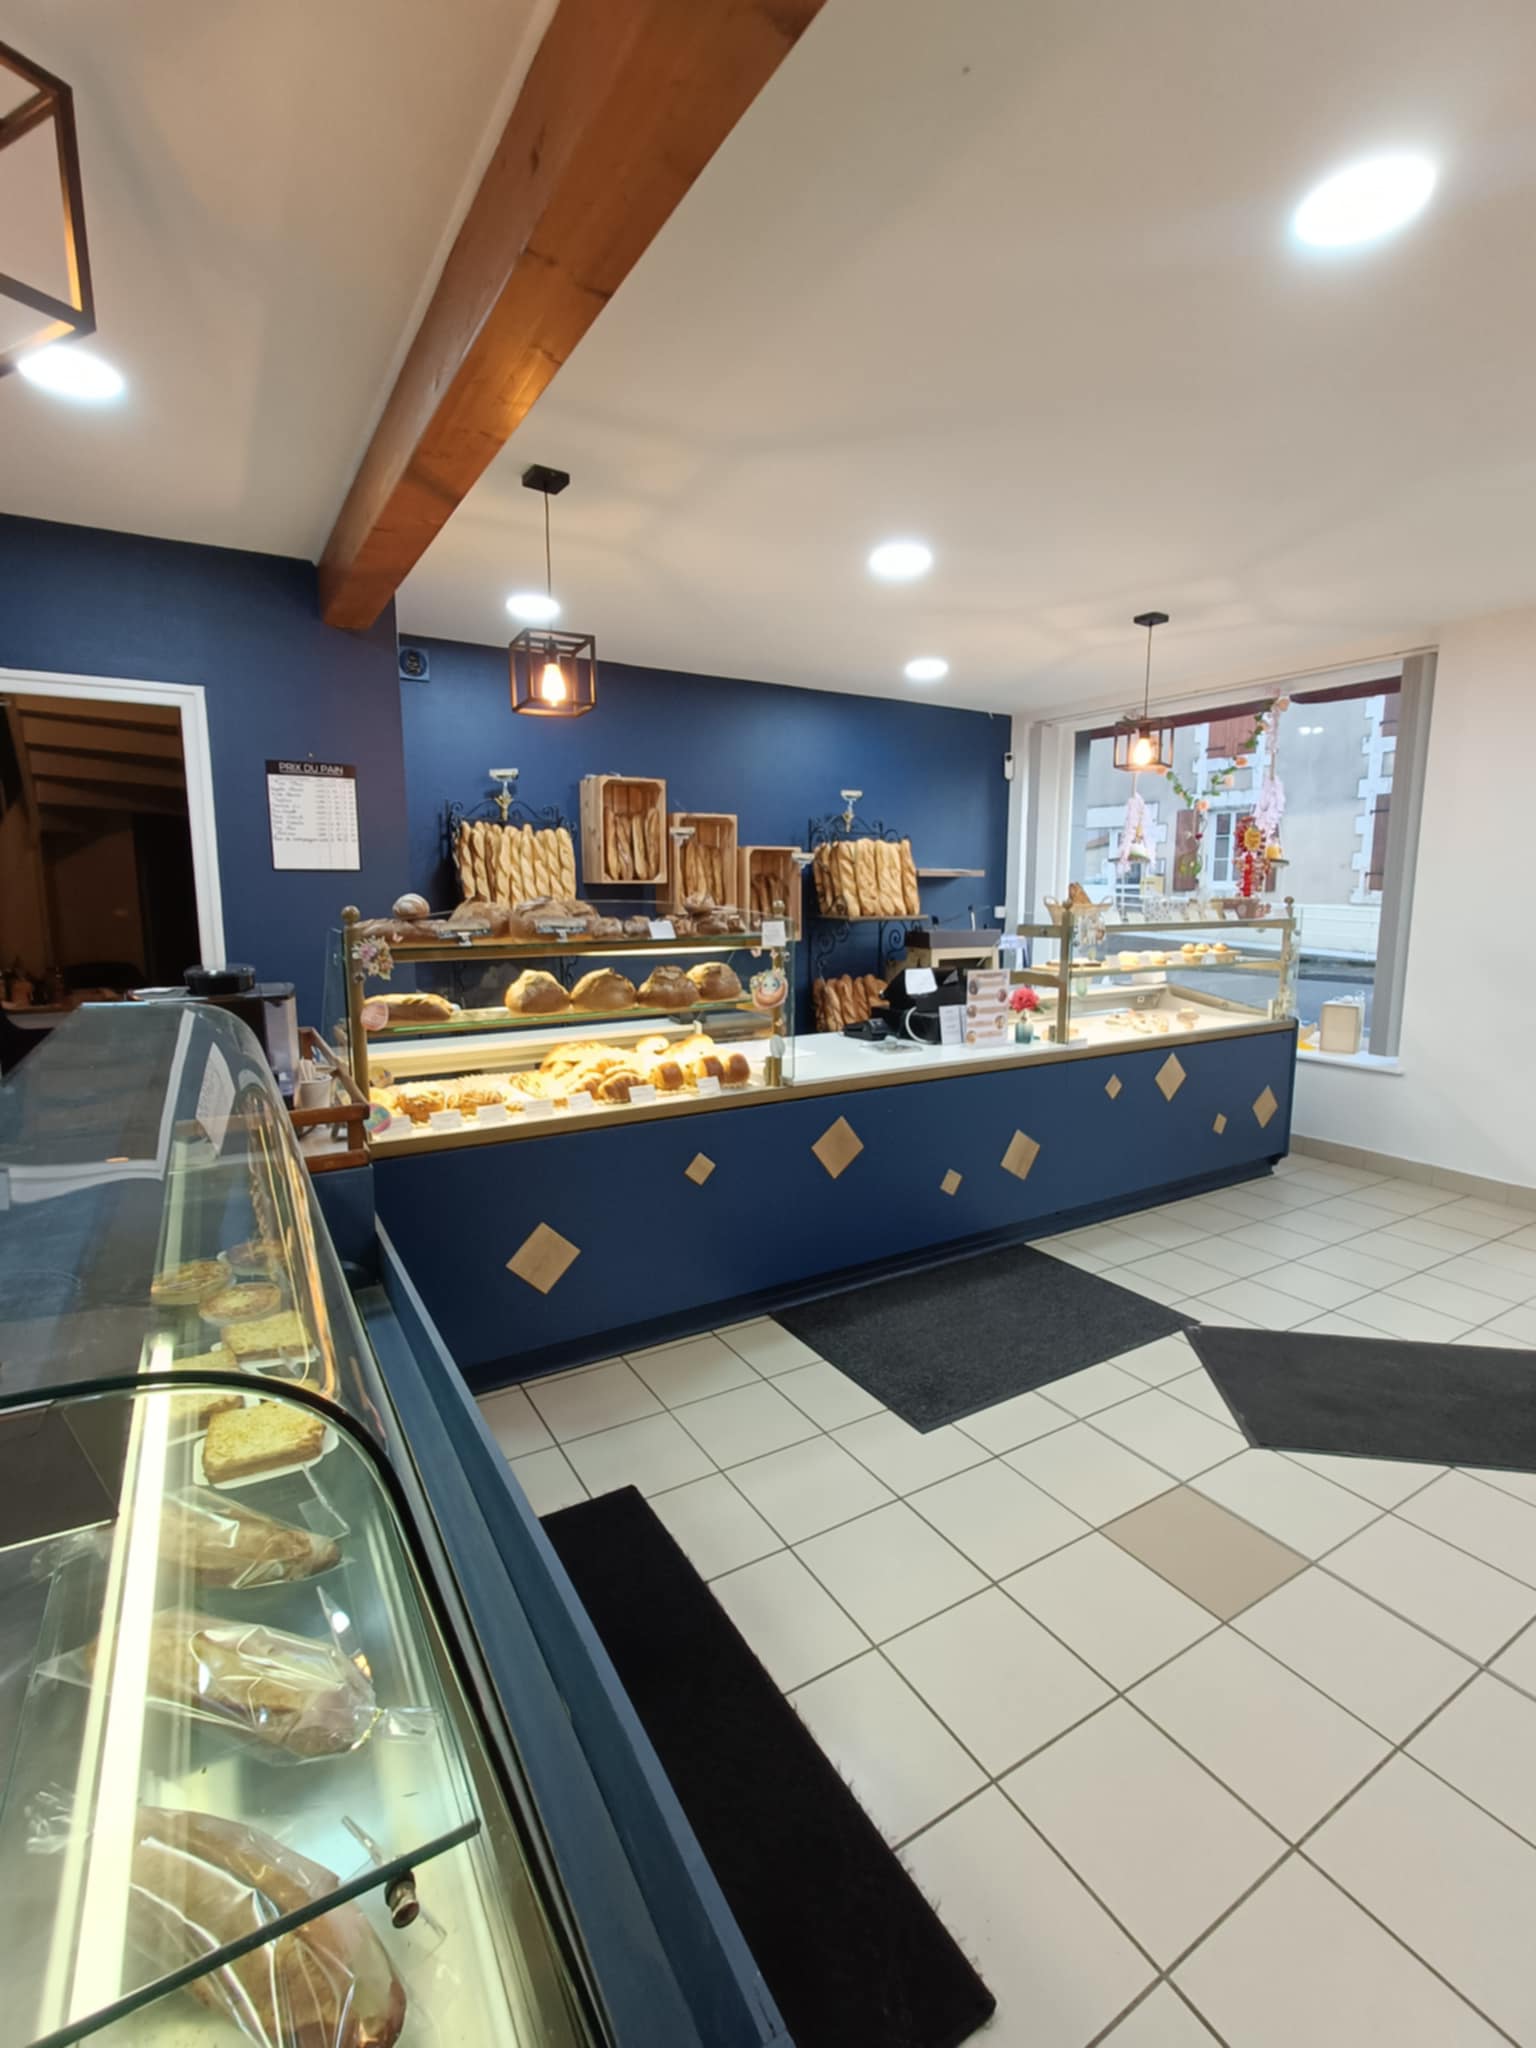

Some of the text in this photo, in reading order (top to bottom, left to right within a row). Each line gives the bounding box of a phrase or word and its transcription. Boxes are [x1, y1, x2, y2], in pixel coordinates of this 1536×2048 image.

[278, 762, 343, 774] PRIX DU PAIN
